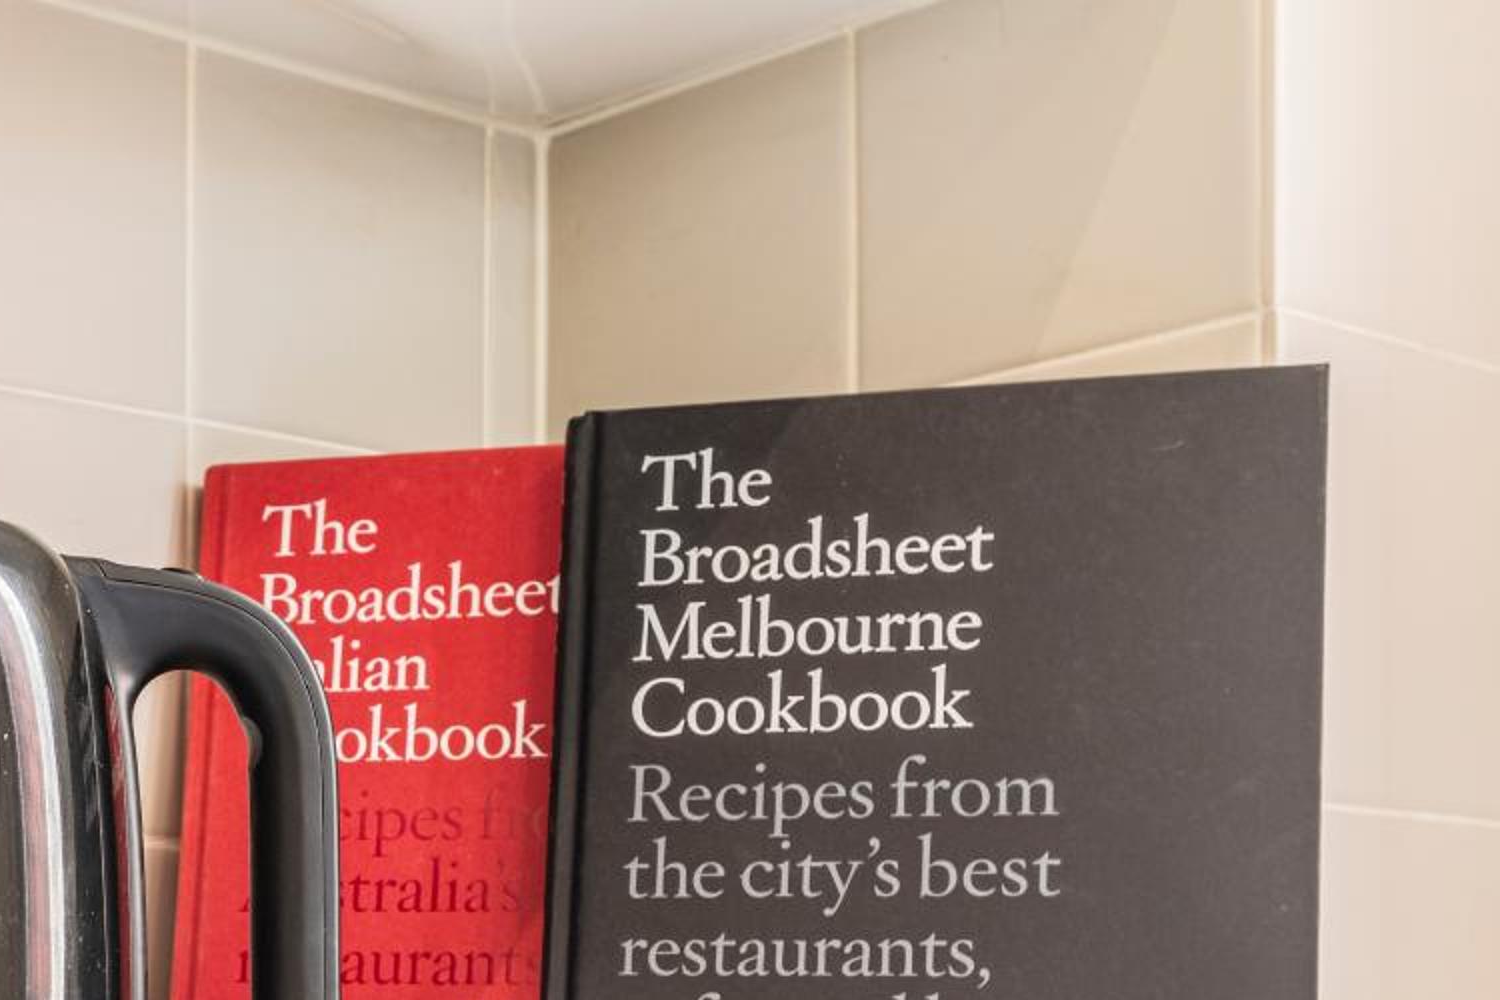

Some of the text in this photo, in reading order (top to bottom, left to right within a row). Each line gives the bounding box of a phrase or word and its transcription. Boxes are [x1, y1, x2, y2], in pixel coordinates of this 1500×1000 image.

[640, 447, 773, 512] The
[261, 497, 379, 558] The
[637, 512, 995, 587] Broadsheet
[259, 560, 561, 625] Broadsheet
[631, 593, 983, 662] Melbourne
[336, 699, 549, 764] okbook
[630, 663, 975, 738] Cookbook
[627, 754, 1061, 838] Recipes from
[622, 832, 1062, 918] the city’s best
[618, 932, 992, 989] restaurants,
